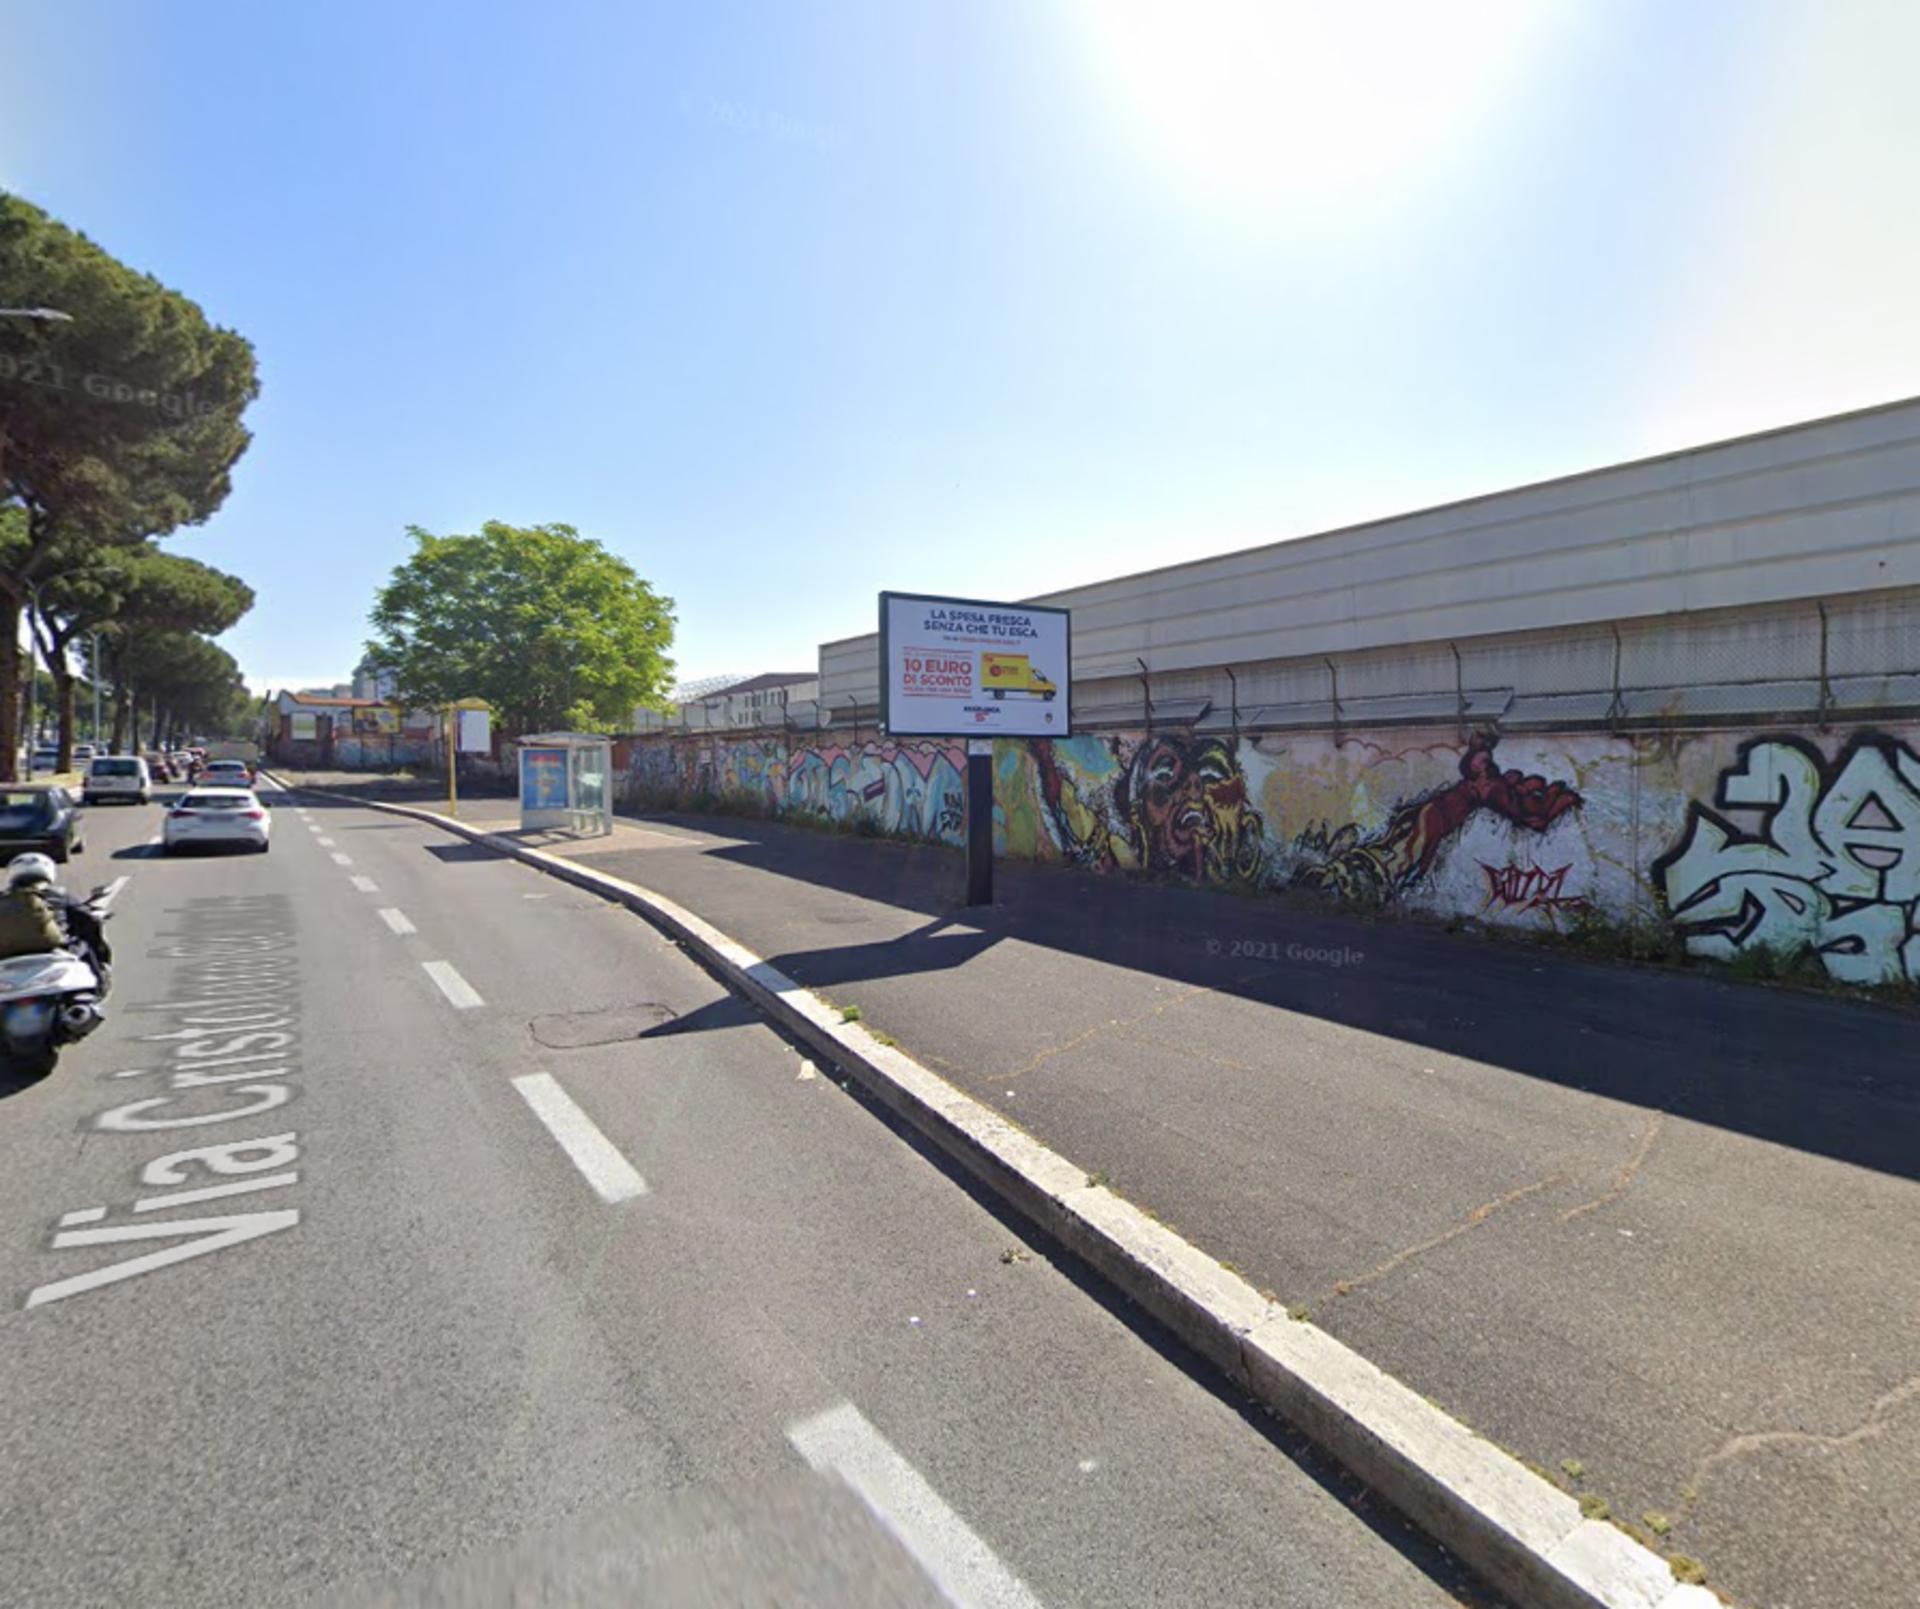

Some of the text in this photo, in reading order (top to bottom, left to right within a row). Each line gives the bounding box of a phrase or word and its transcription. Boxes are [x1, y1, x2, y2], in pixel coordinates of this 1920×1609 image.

[931, 610, 1031, 626] LA SPESA FRESCA
[924, 620, 1037, 637] SENZA CHE TU ESCA
[904, 658, 972, 675] 10 EURO
[903, 673, 972, 687] DI SCONTO
